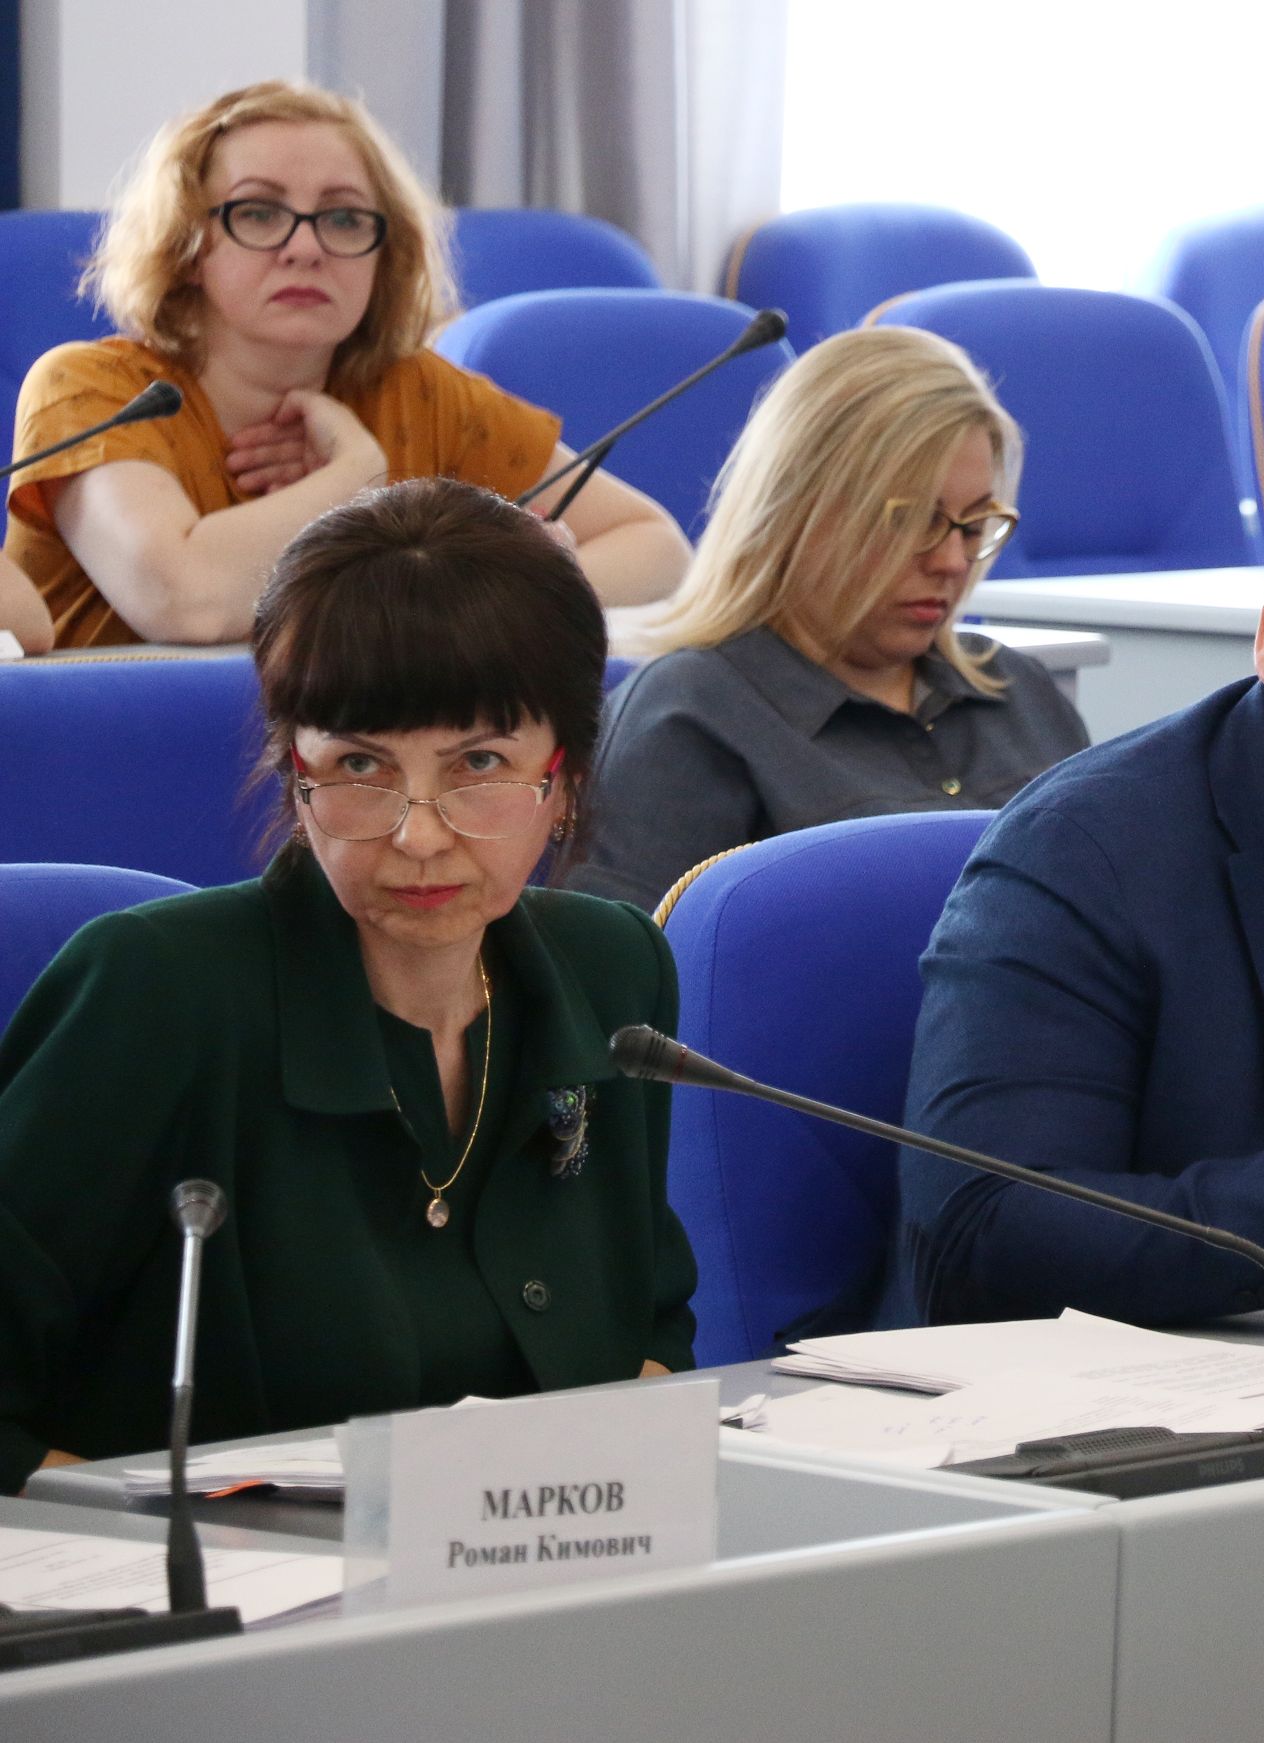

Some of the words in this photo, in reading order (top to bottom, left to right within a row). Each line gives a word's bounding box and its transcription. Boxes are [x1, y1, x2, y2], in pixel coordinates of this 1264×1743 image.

[480, 1480, 626, 1522] МАРКОВ
[447, 1539, 529, 1569] Роман
[536, 1533, 653, 1563] Кимович
